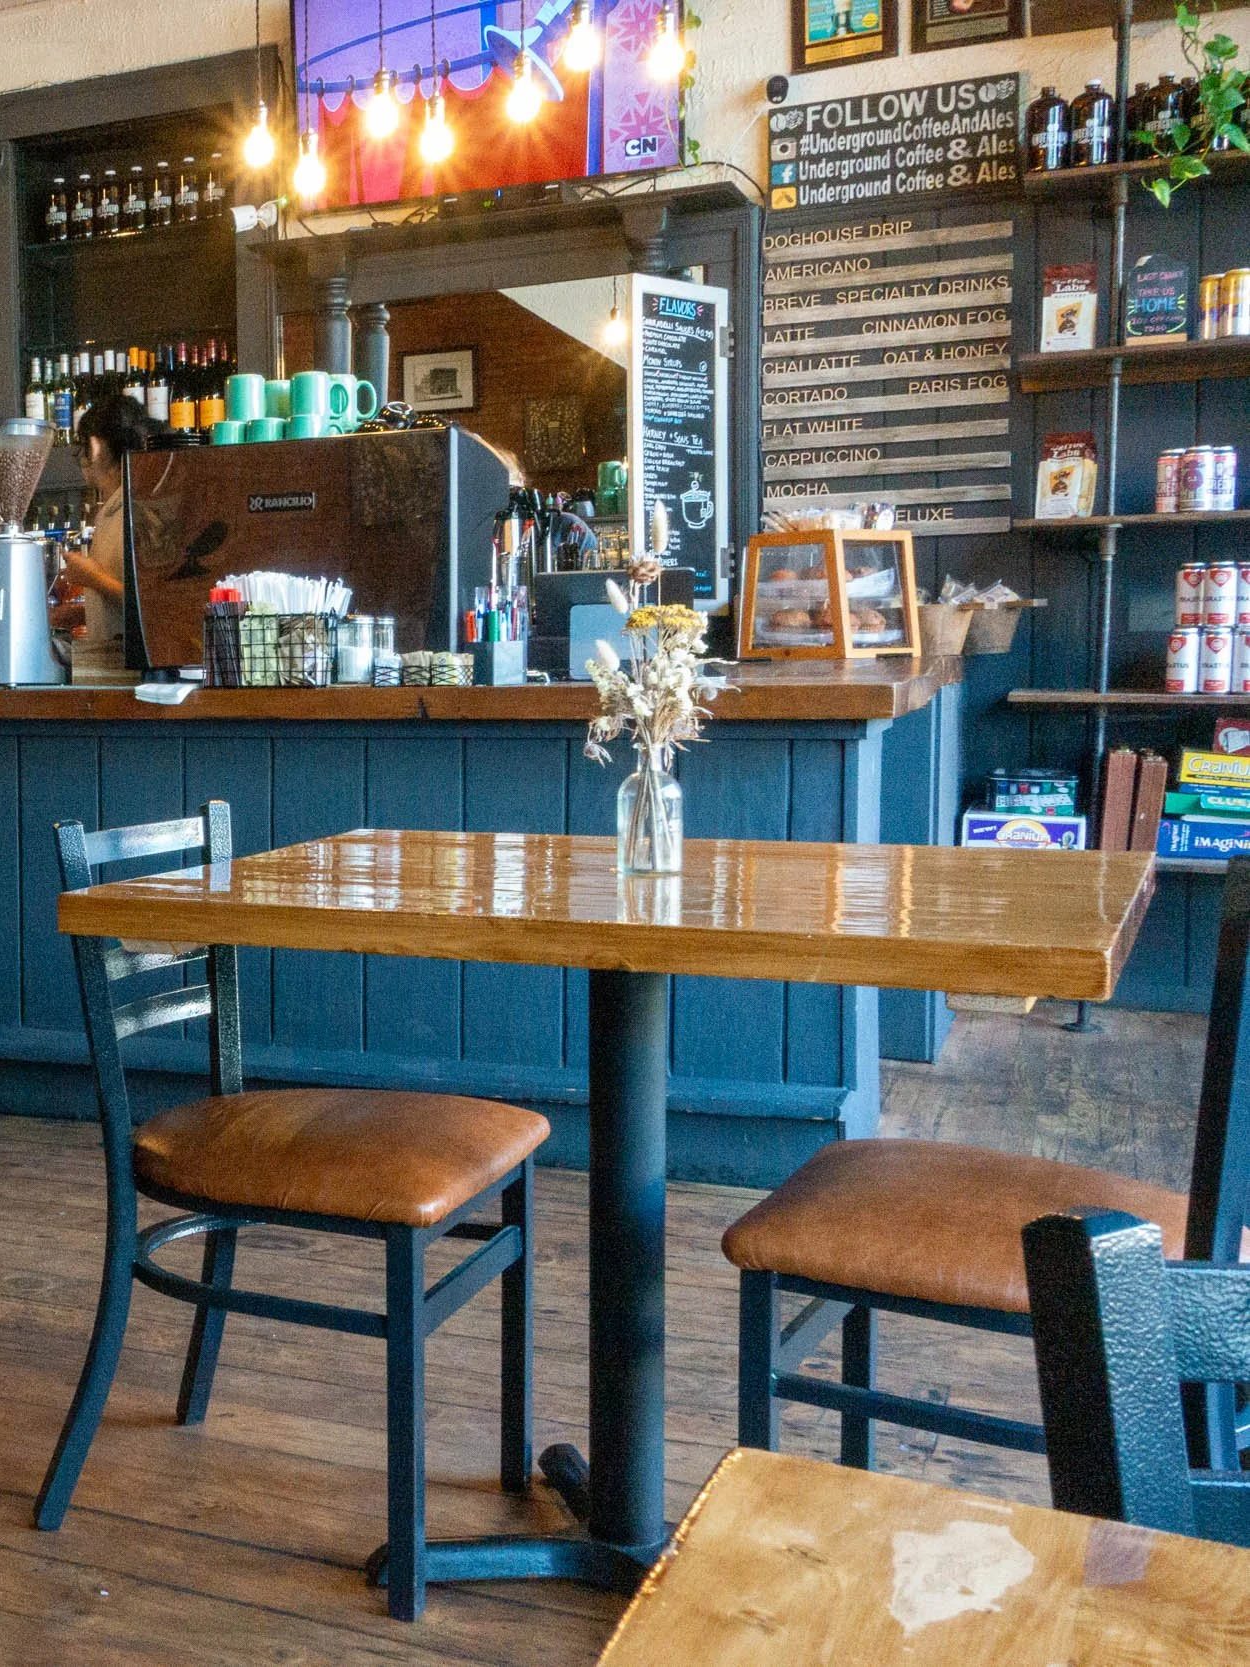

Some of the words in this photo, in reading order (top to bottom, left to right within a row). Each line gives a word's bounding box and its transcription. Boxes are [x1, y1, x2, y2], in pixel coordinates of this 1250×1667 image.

[806, 89, 928, 132] FOLLOW
[937, 83, 976, 113] US
[800, 111, 1015, 157] #UndergroundCoffeeAndAles
[626, 136, 657, 157] CN
[799, 156, 891, 181] Underground
[896, 144, 944, 169] Coffee
[947, 137, 973, 160] &
[976, 134, 1016, 158] Ales
[800, 180, 891, 205] Underground
[896, 170, 944, 194] Coffee
[947, 164, 973, 187] &
[976, 161, 1016, 184] Ales
[763, 226, 863, 250] DOGHOUSE
[869, 220, 912, 238] DRIP
[765, 257, 870, 281] AMERICANO
[836, 283, 934, 305] SPECIALTY
[939, 275, 1009, 295] DRINKS
[1055, 283, 1087, 293] Labs
[658, 296, 697, 319] FLAVORS
[764, 294, 821, 312] BREVE
[1134, 296, 1177, 314] HOME
[862, 313, 960, 336] CINNAMON
[967, 308, 1007, 325] FOG
[764, 327, 815, 344] LATTE
[883, 350, 919, 365] OAT
[924, 348, 935, 361] &
[941, 342, 1008, 361] HONEY
[908, 378, 961, 394] PARIS
[967, 375, 1007, 390] FOG
[764, 387, 848, 406] CORTADO
[763, 423, 802, 438] FLAT
[807, 418, 863, 435] WHITE
[765, 447, 880, 468] CAPPUCCINO
[767, 482, 830, 499] MOCHA
[894, 507, 954, 522] ELUXE
